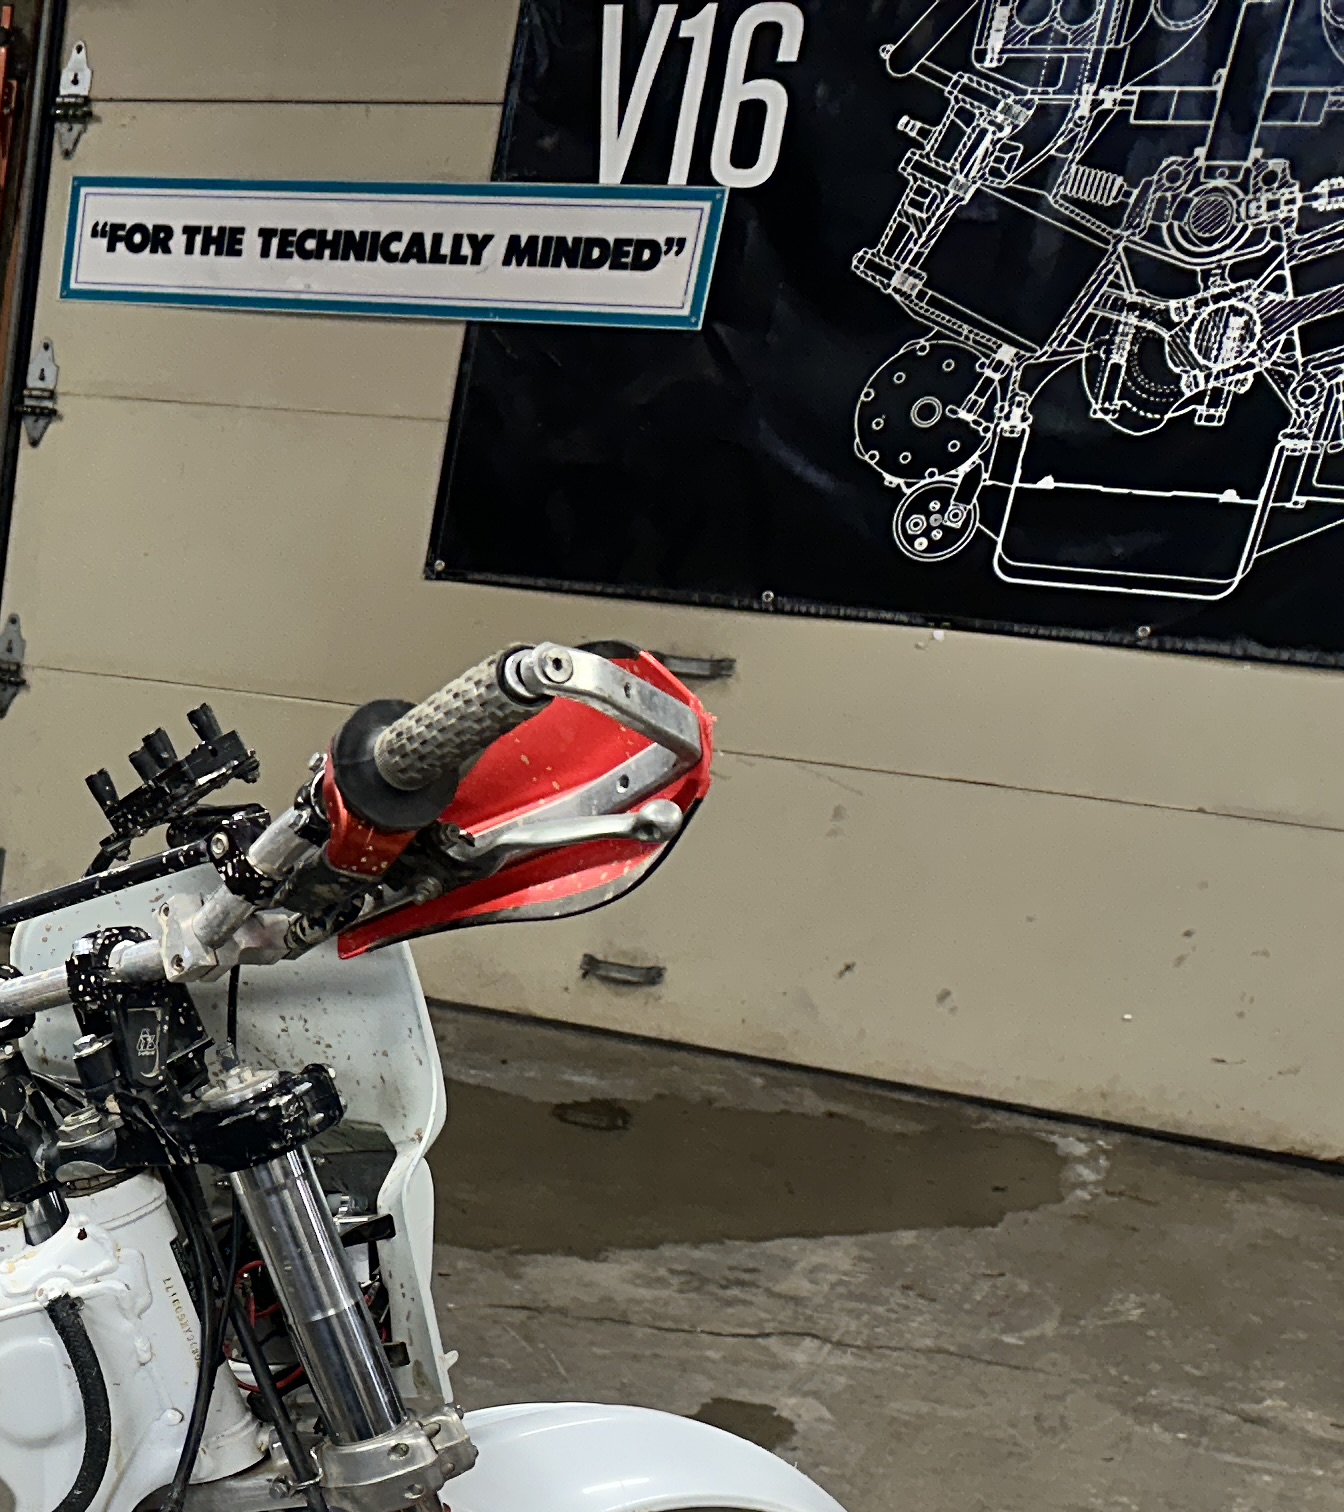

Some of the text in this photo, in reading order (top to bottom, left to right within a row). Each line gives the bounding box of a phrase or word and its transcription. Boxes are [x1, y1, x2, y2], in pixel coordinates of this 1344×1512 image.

[599, 1, 805, 189] V16
[183, 225, 244, 258] THE
[257, 227, 494, 267] TECHNICALLY
